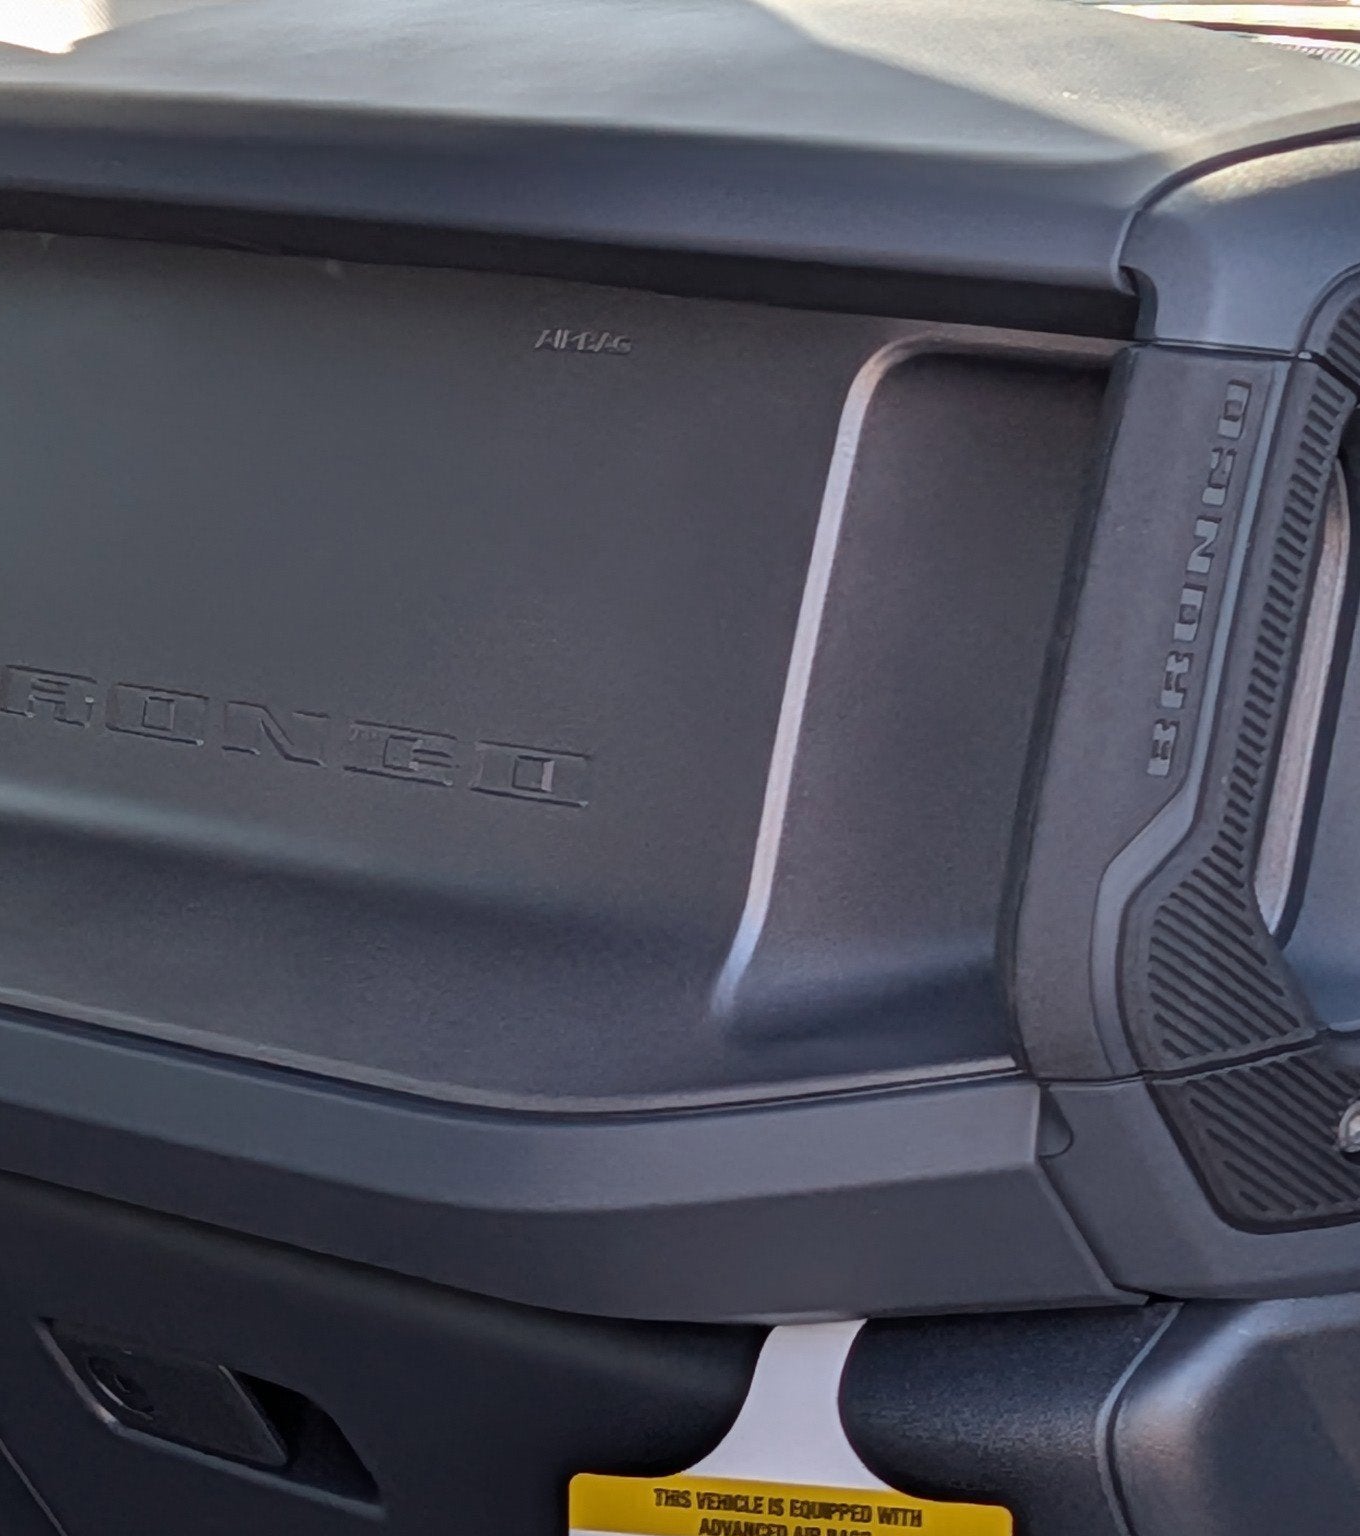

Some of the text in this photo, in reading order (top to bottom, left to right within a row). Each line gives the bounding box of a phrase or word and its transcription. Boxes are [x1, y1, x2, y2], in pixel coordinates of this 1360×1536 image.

[1146, 377, 1253, 778] BRONCO
[653, 1487, 923, 1528] THIS VEHICLE IS EQUIPPED WITH
